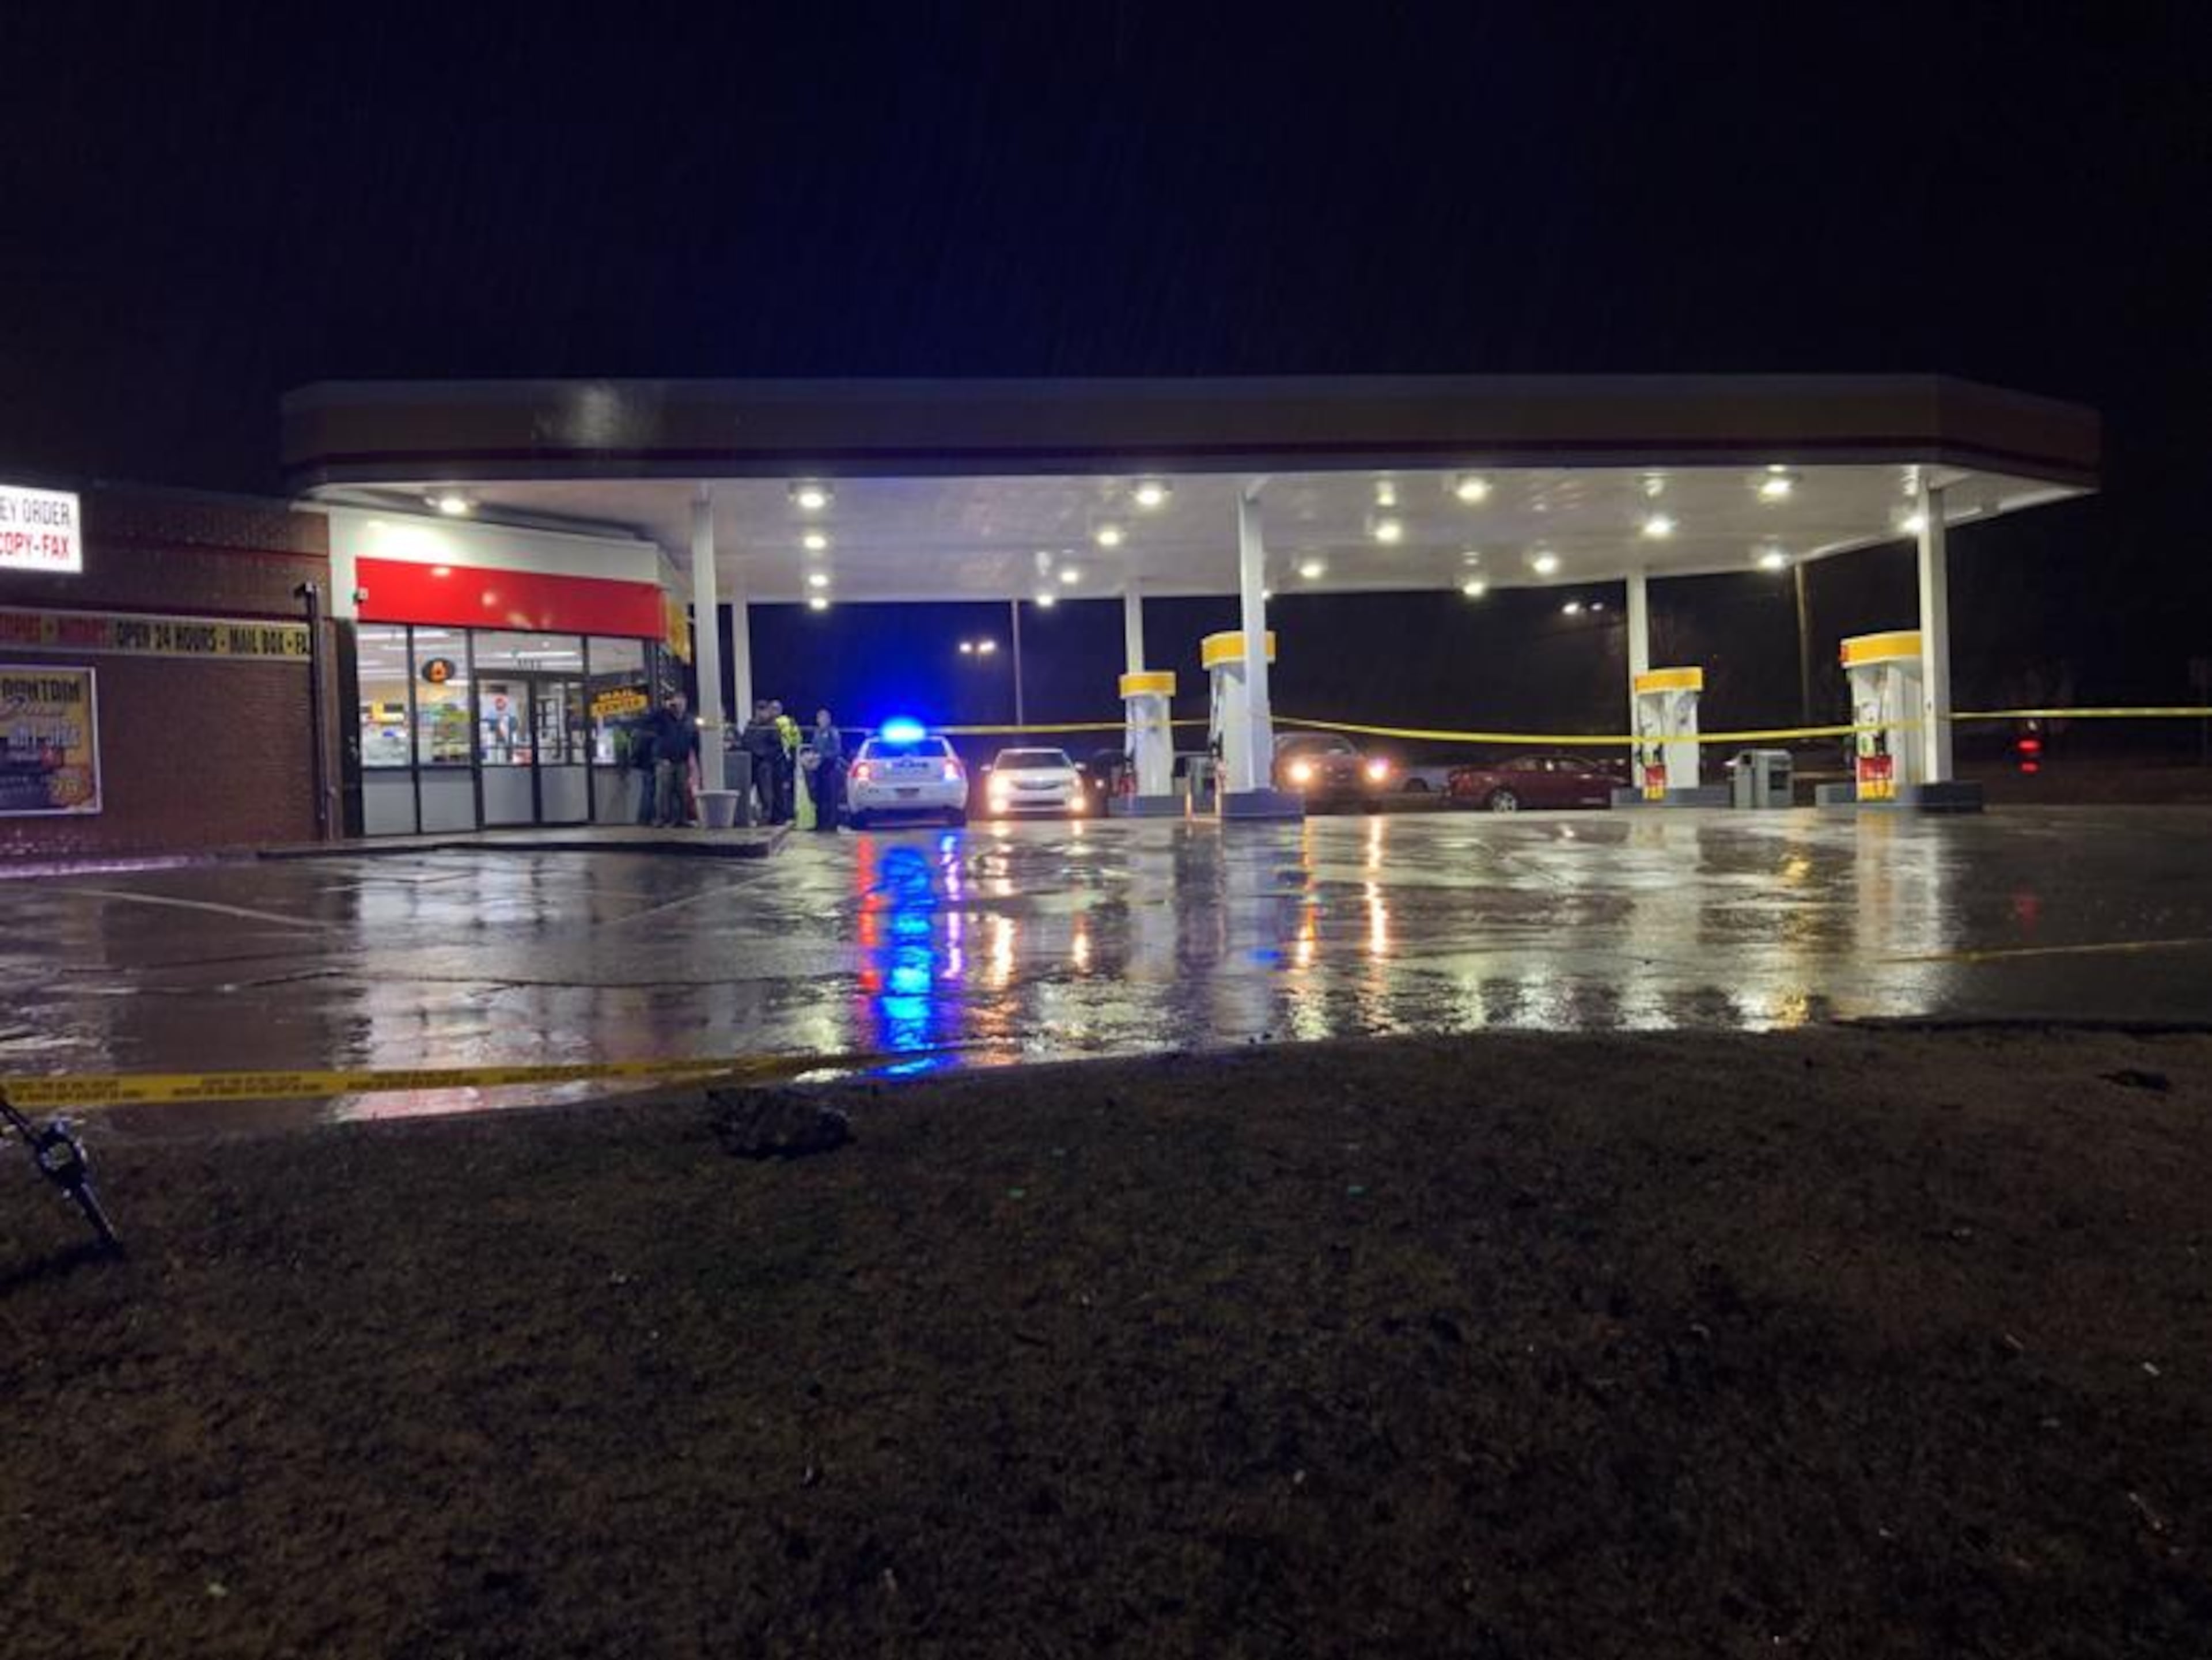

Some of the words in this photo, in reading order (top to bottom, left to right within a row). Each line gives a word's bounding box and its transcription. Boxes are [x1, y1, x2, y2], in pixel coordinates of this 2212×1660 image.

[22, 498, 70, 526] ORDER
[155, 623, 172, 650] 24
[175, 624, 217, 652] HOURS
